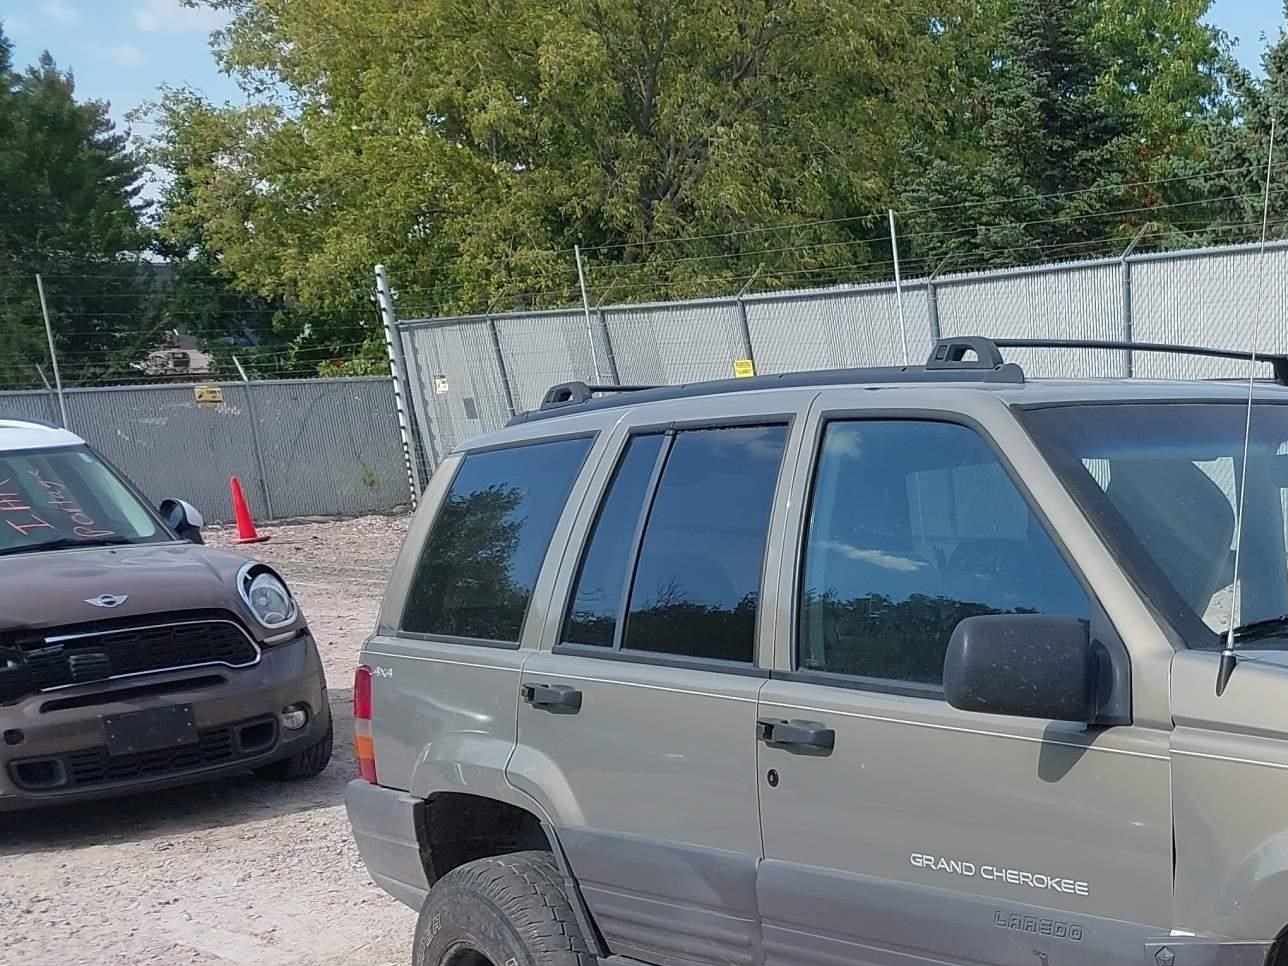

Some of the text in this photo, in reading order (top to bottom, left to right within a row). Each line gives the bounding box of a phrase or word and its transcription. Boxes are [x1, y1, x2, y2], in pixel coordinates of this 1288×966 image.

[910, 852, 1090, 896] GRAND CHEROKEE
[993, 909, 1084, 942] LAREDO
